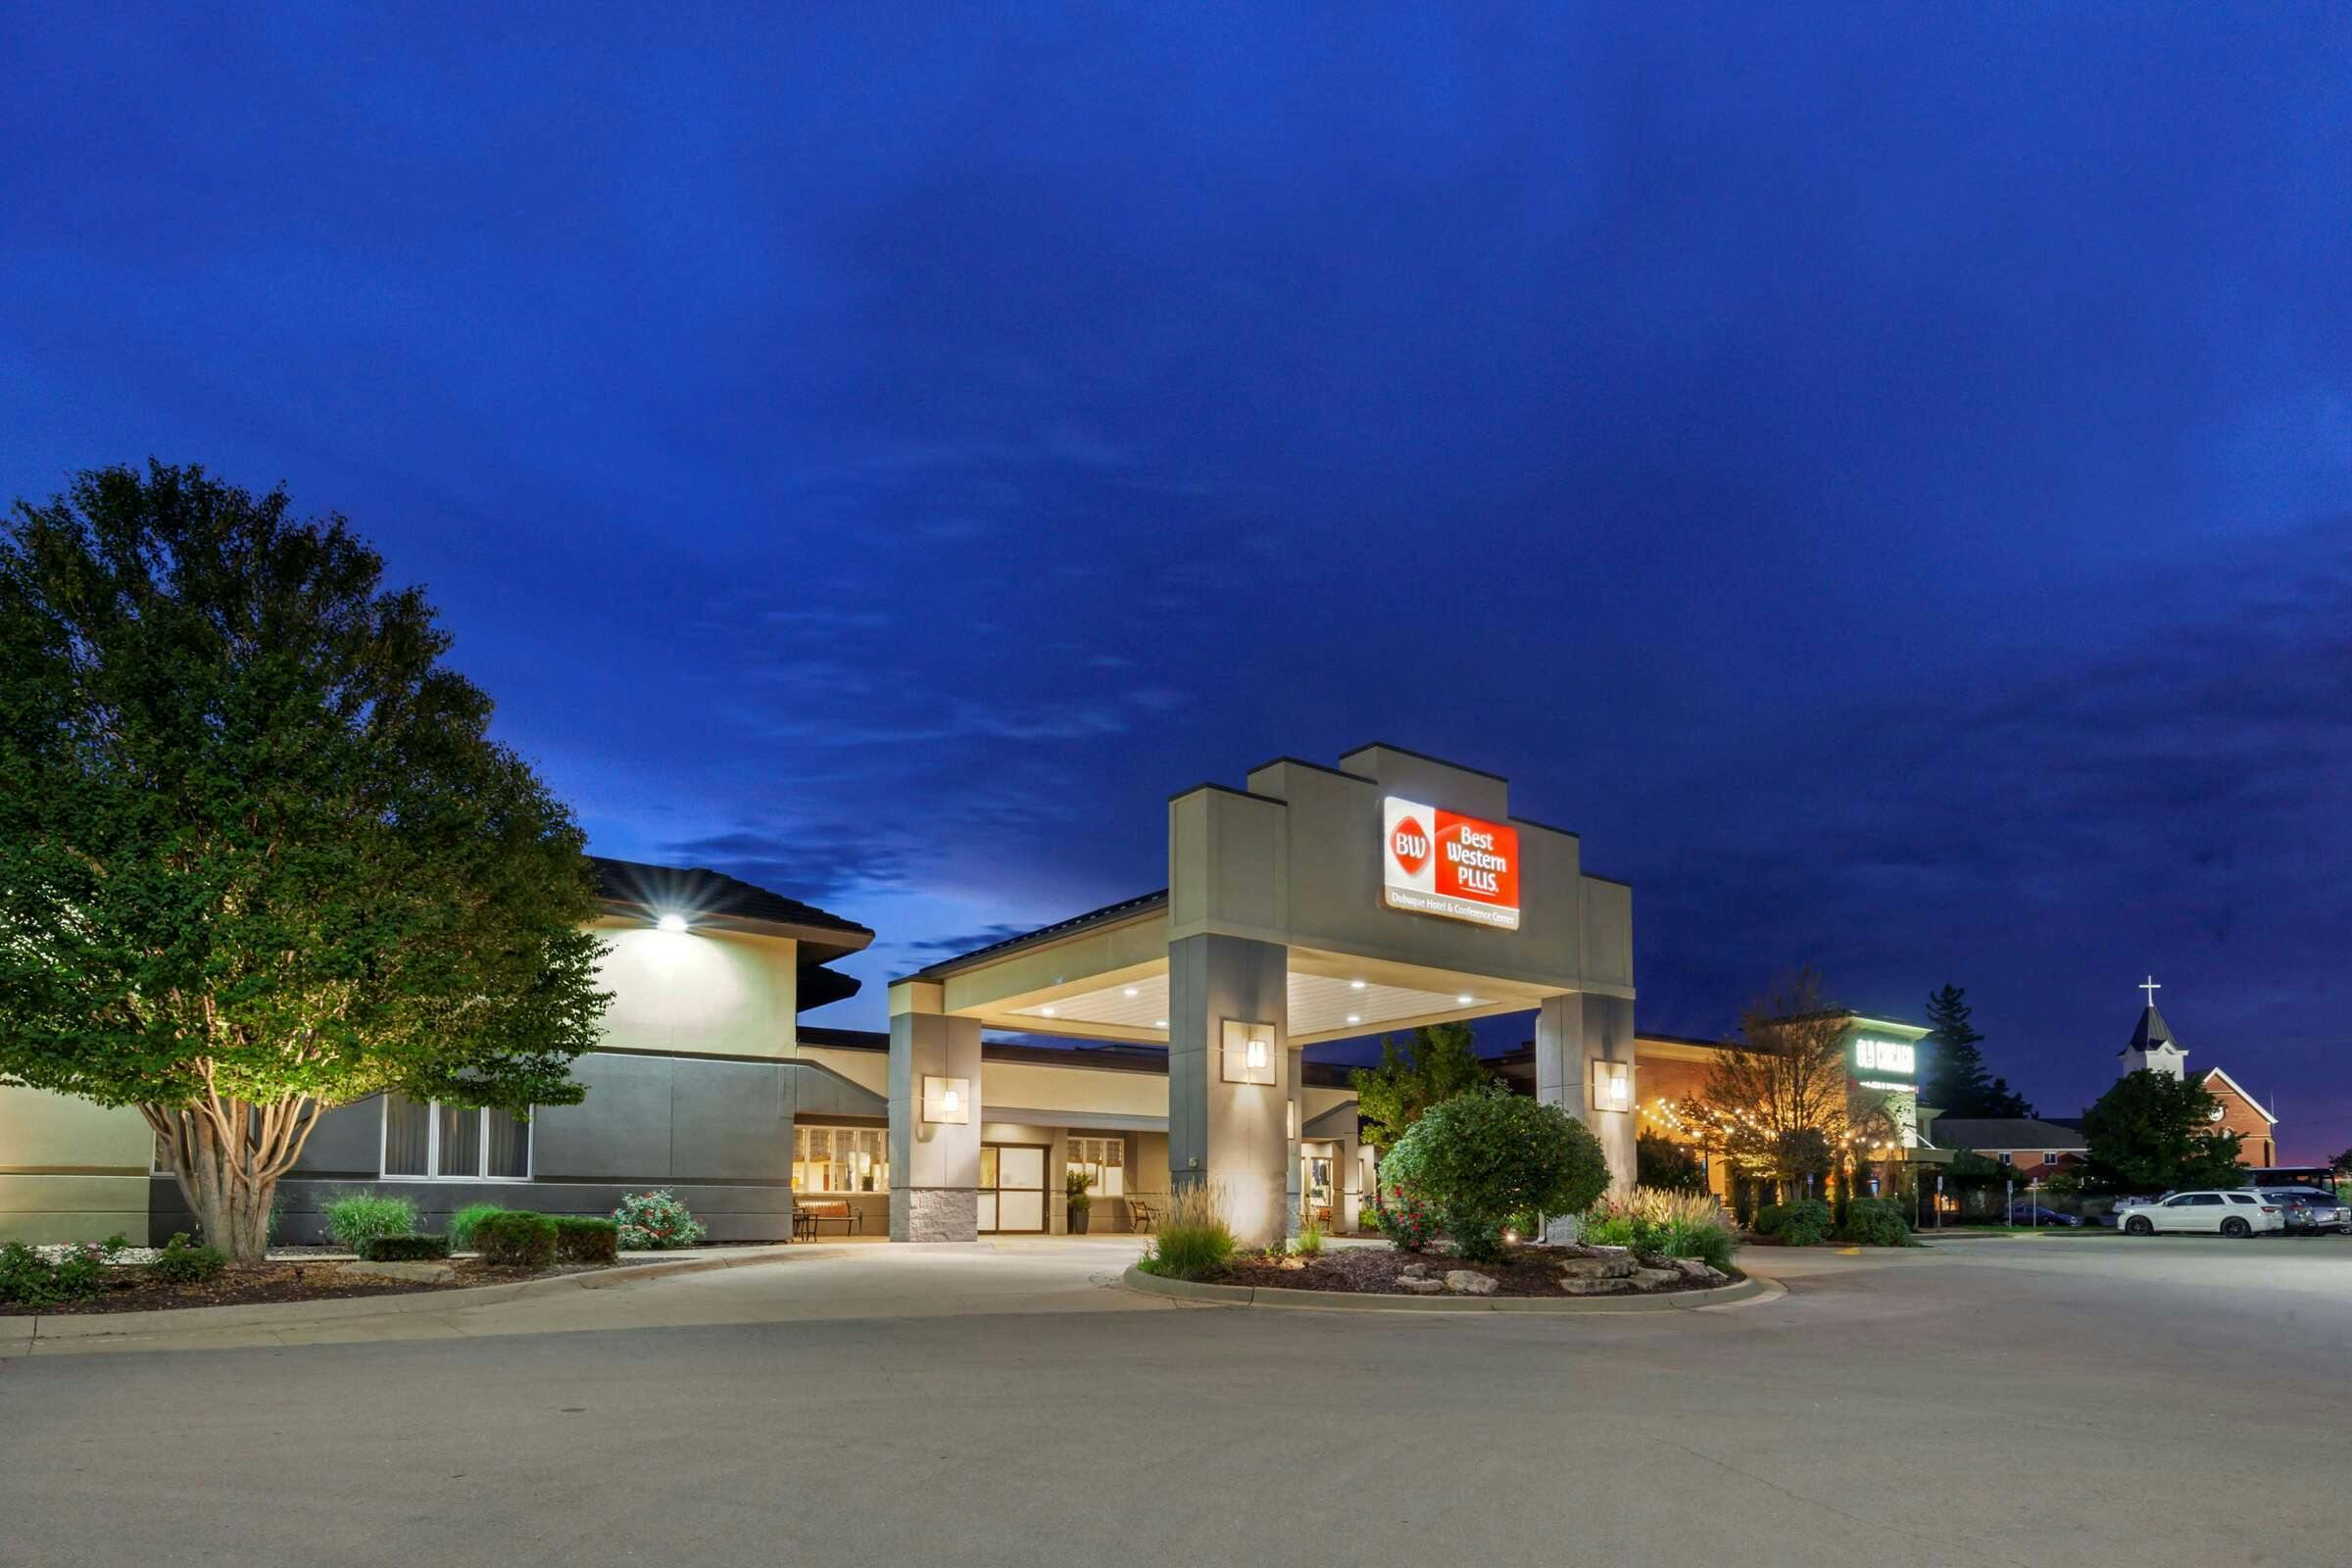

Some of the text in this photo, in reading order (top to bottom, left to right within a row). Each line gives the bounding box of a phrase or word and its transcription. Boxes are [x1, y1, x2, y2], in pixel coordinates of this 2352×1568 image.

[1396, 832, 1427, 858] BW
[1460, 826, 1494, 851] Best
[1446, 842, 1506, 872] Western
[1458, 866, 1496, 891] PLUS
[1426, 899, 1446, 912] Hotel
[1447, 902, 1454, 912] &
[1454, 904, 1491, 920] Conference
